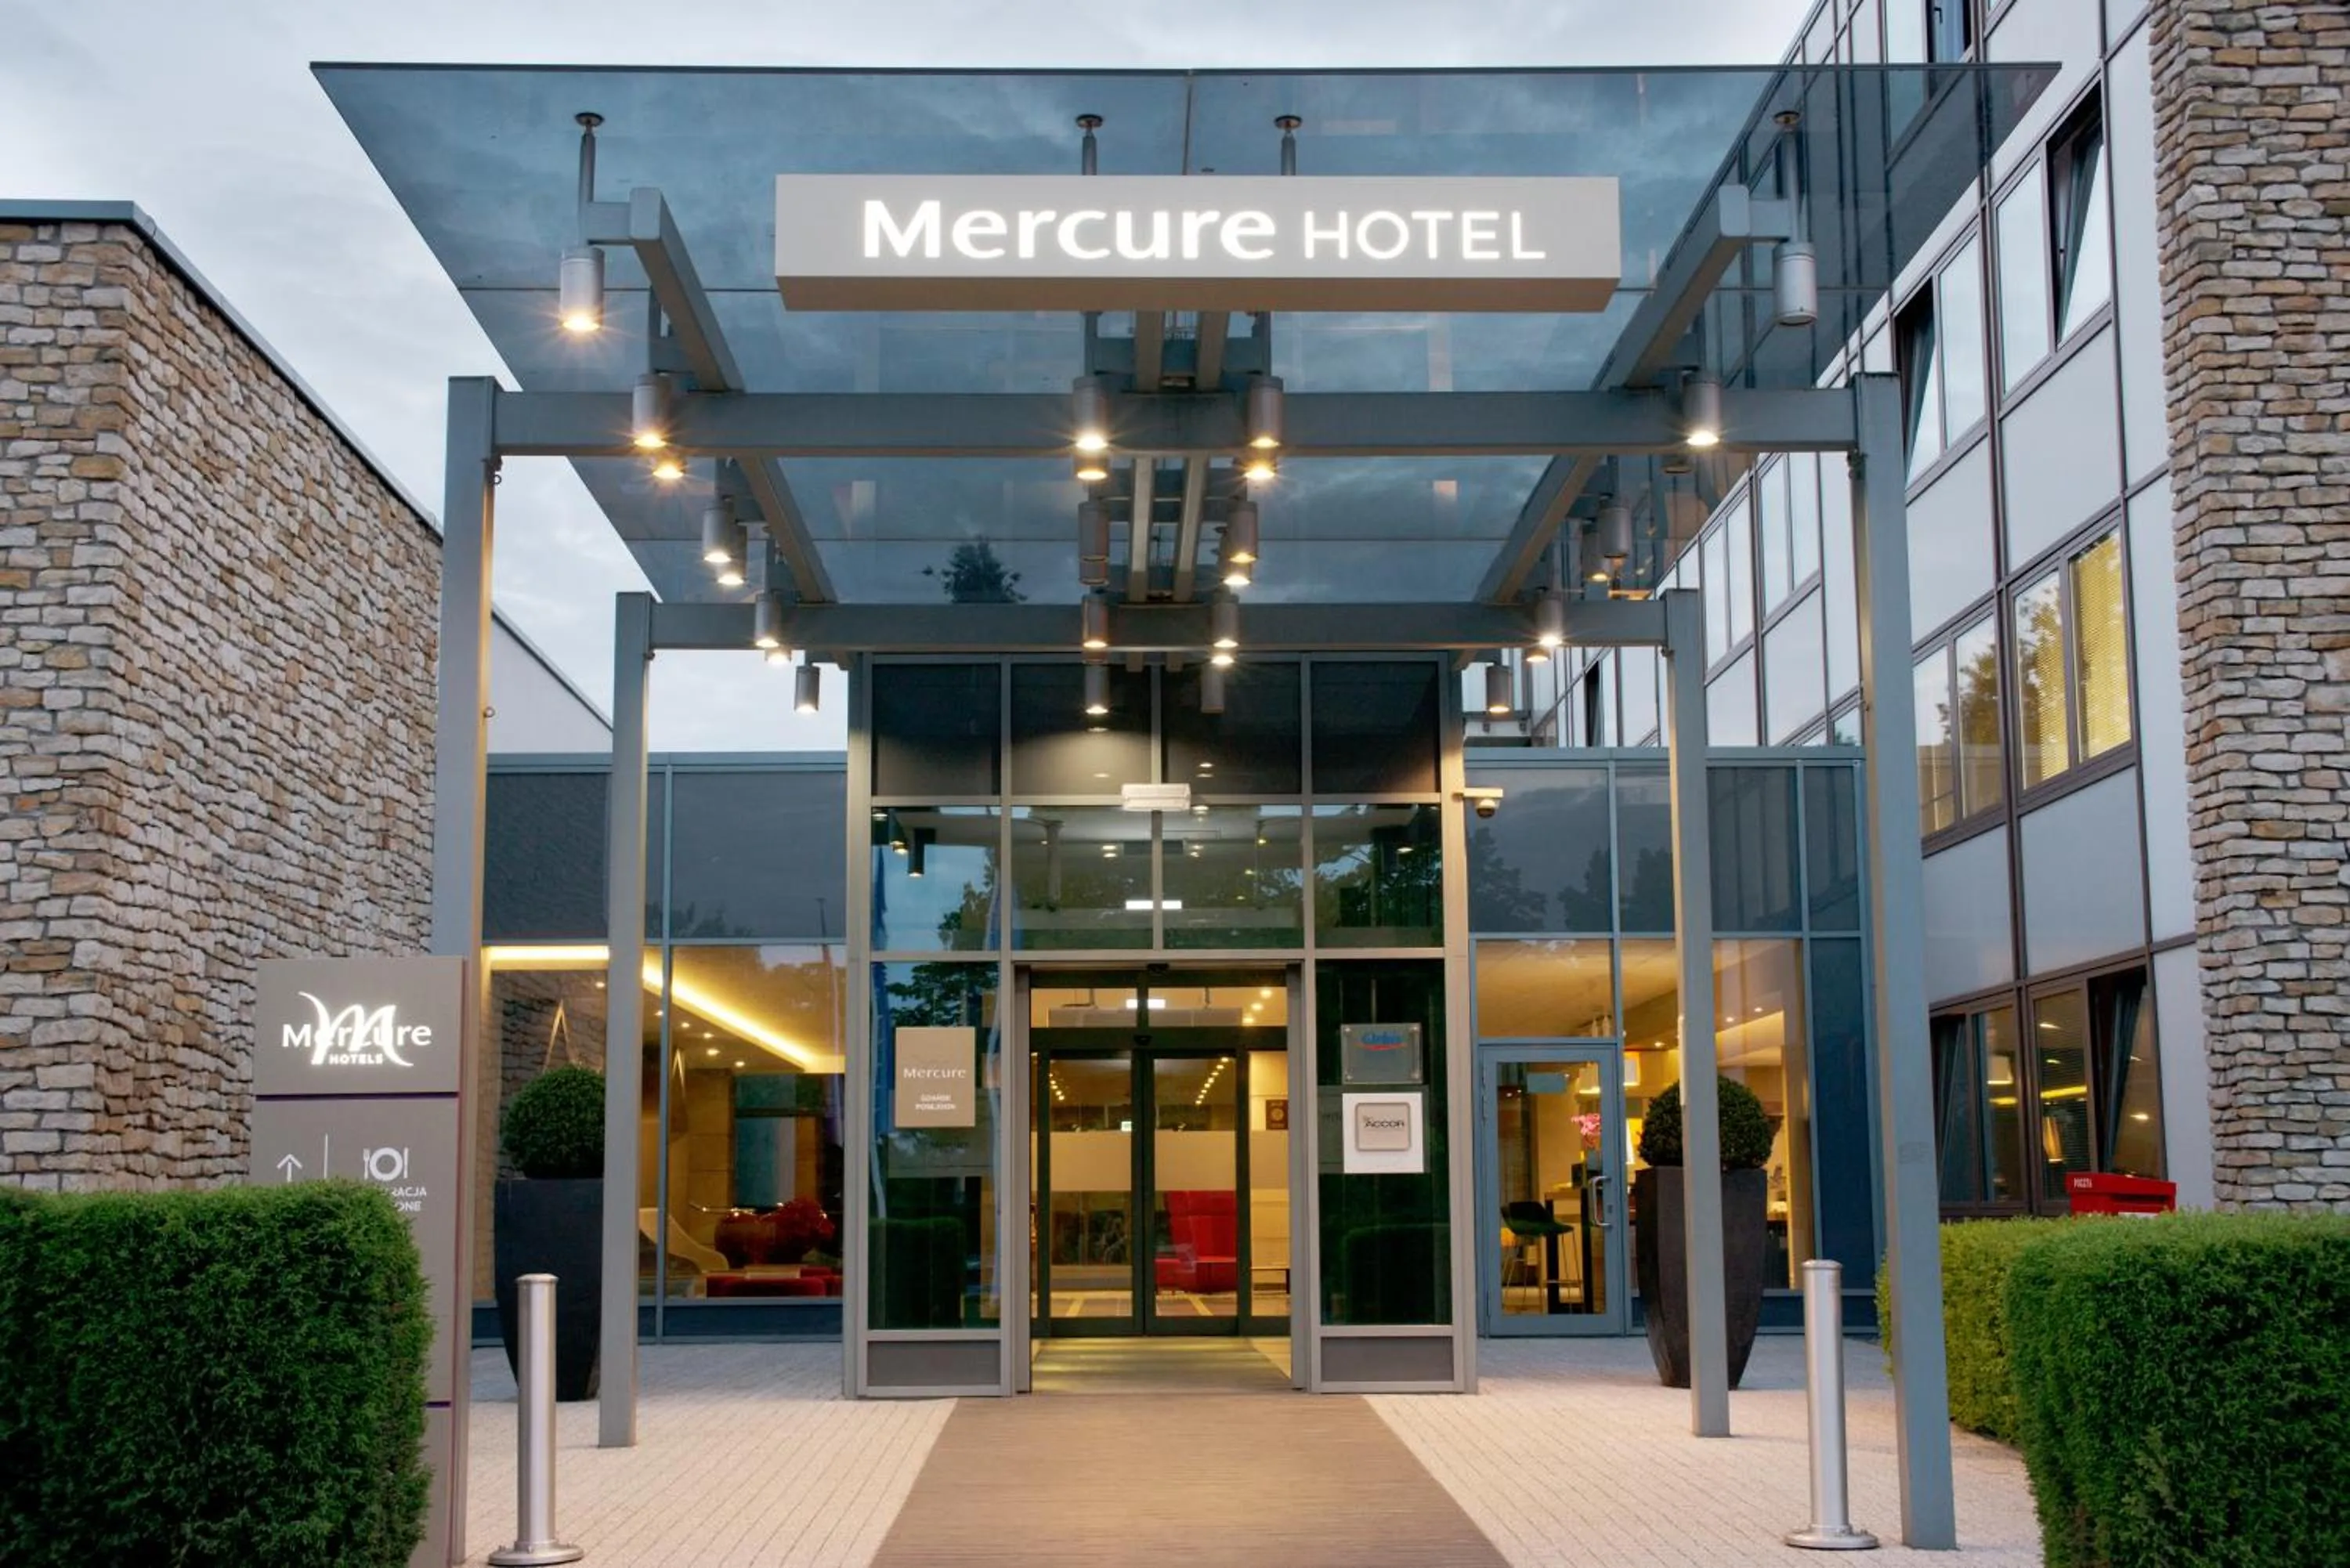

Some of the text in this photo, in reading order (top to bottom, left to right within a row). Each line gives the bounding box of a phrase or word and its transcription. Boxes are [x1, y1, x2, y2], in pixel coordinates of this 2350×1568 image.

[863, 200, 1546, 260] Mercure HOTEL
[282, 1023, 432, 1048] Mrure
[328, 1053, 384, 1065] HOTELS
[903, 1068, 967, 1078] Mercure
